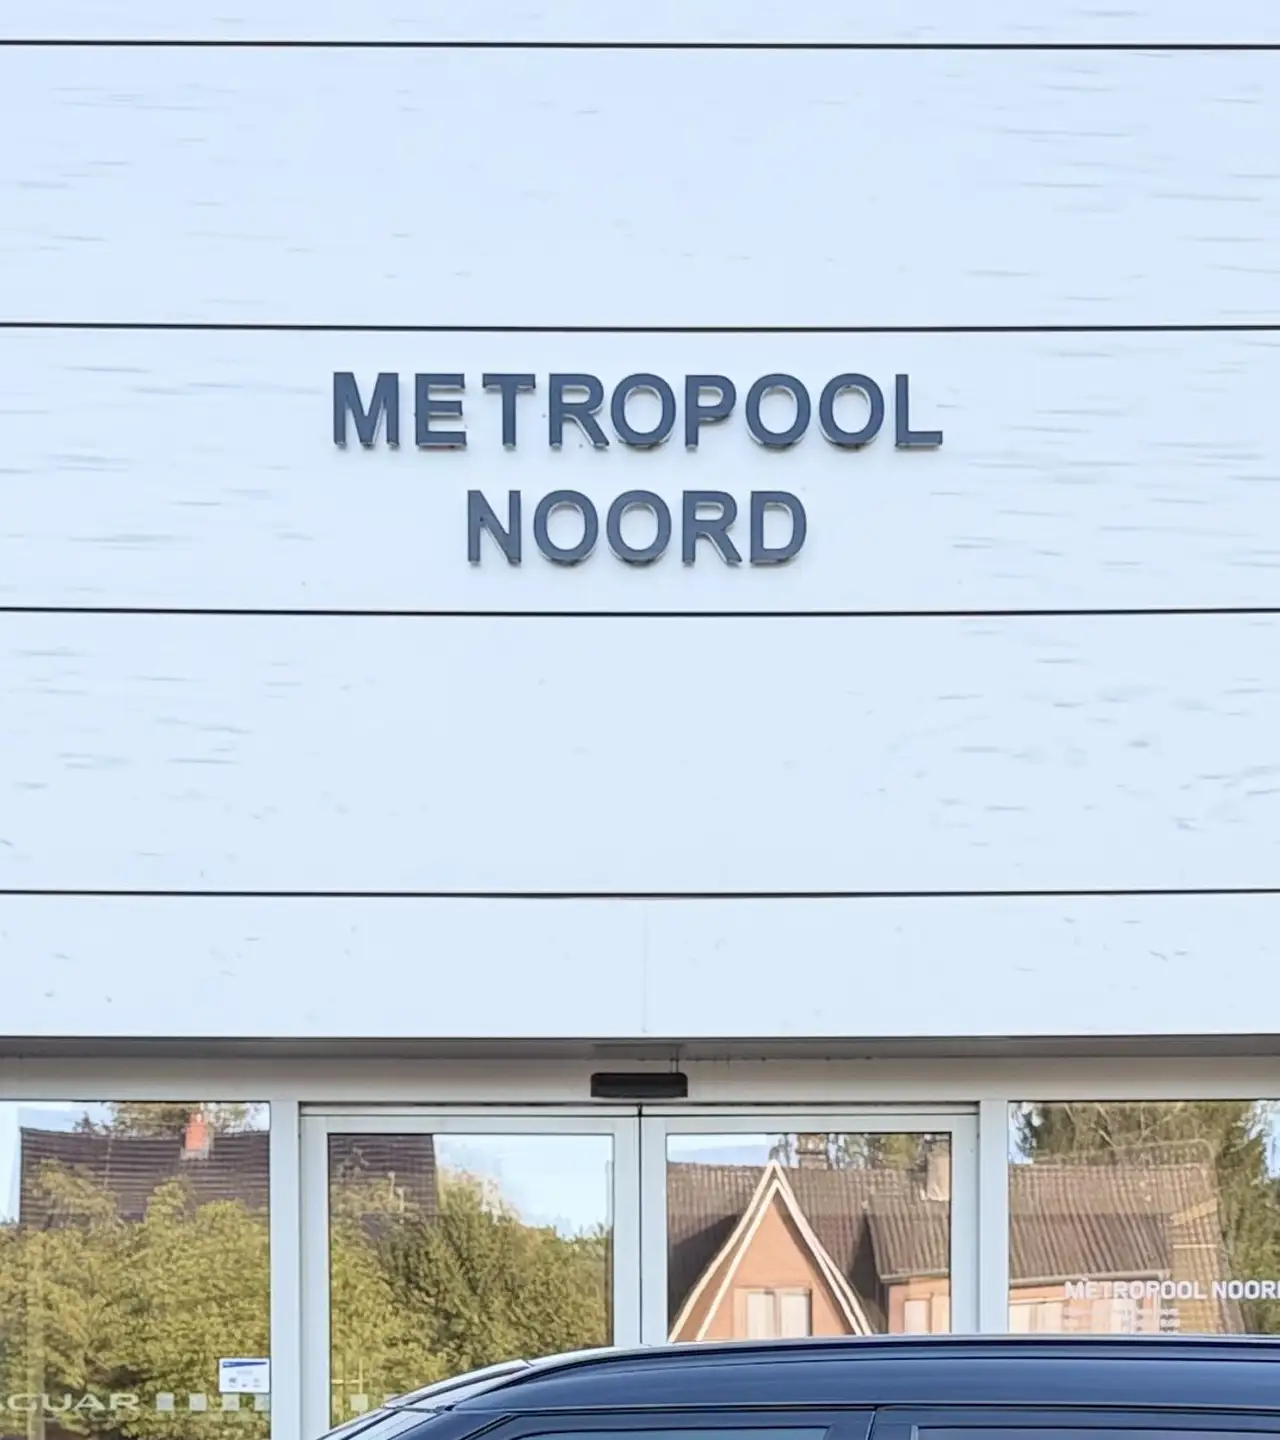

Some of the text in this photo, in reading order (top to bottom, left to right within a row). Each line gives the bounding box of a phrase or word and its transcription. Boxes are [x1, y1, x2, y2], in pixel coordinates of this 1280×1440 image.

[332, 371, 944, 450] METROPOOL
[466, 489, 809, 567] NOORD
[1064, 1280, 1207, 1300] METROPOOL
